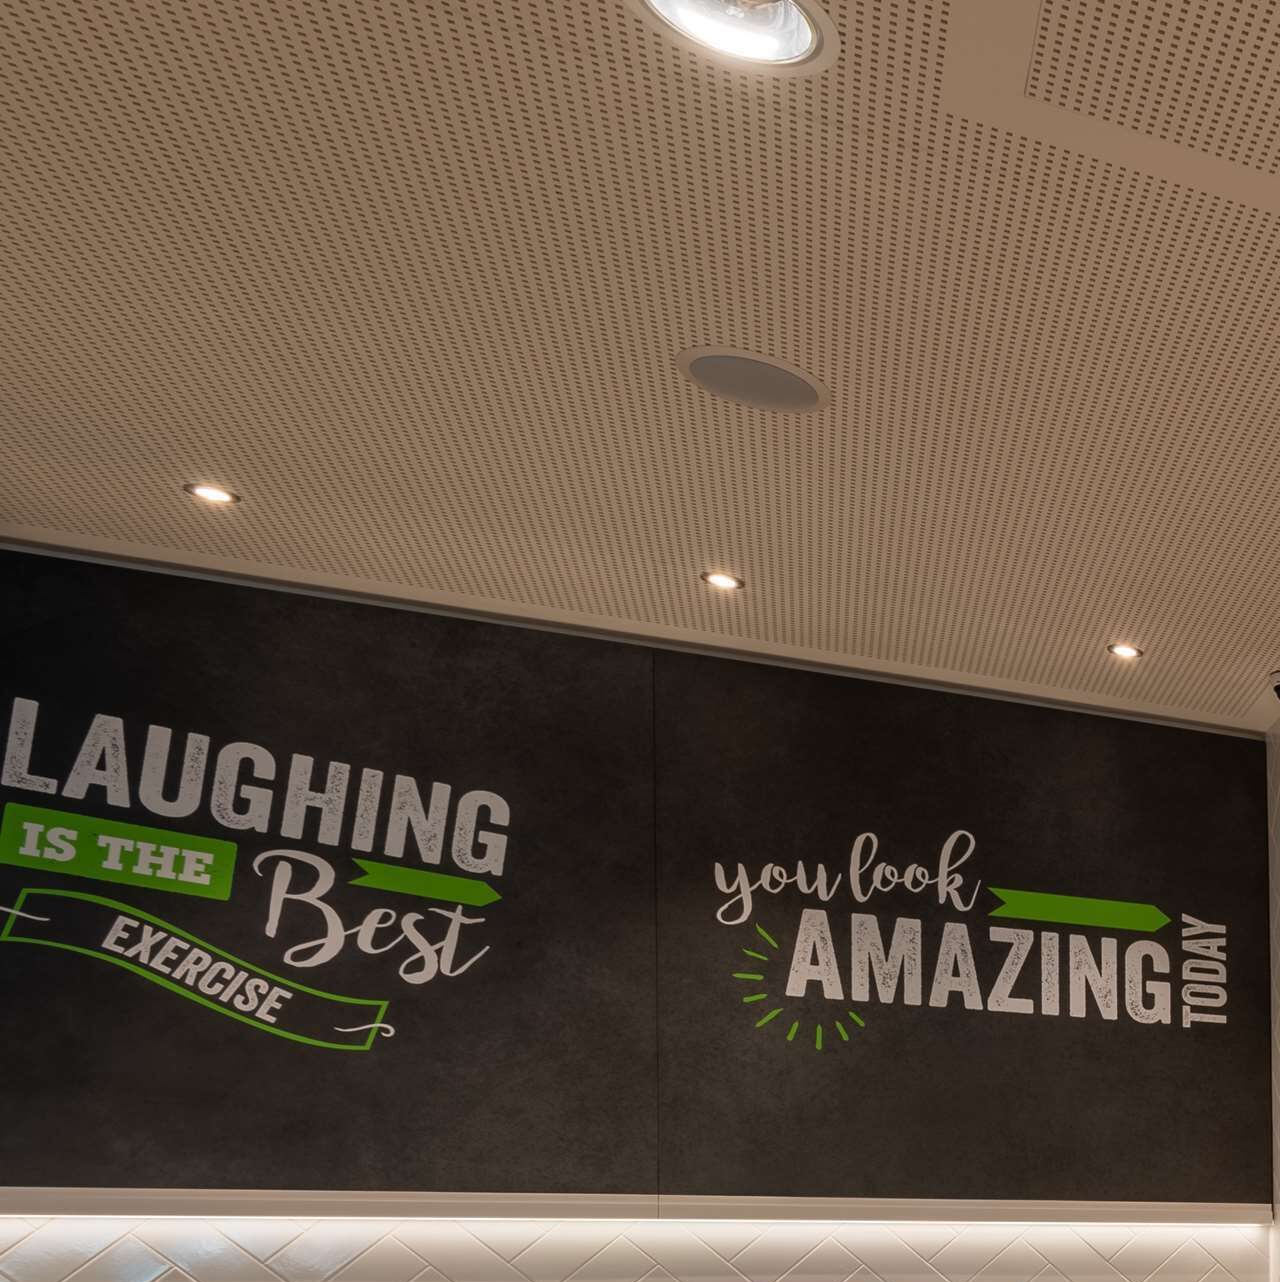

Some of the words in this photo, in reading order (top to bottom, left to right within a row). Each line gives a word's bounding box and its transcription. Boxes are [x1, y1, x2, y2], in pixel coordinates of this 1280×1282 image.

[1, 697, 511, 877] LAUGHING
[18, 821, 78, 863] IS
[95, 834, 215, 886] THE
[714, 860, 842, 925] you
[849, 830, 981, 912] look
[101, 915, 293, 1024] EXERCISE
[252, 849, 491, 984] Best
[785, 908, 1172, 1025] AMAZING
[1182, 913, 1228, 1028] TODAY
